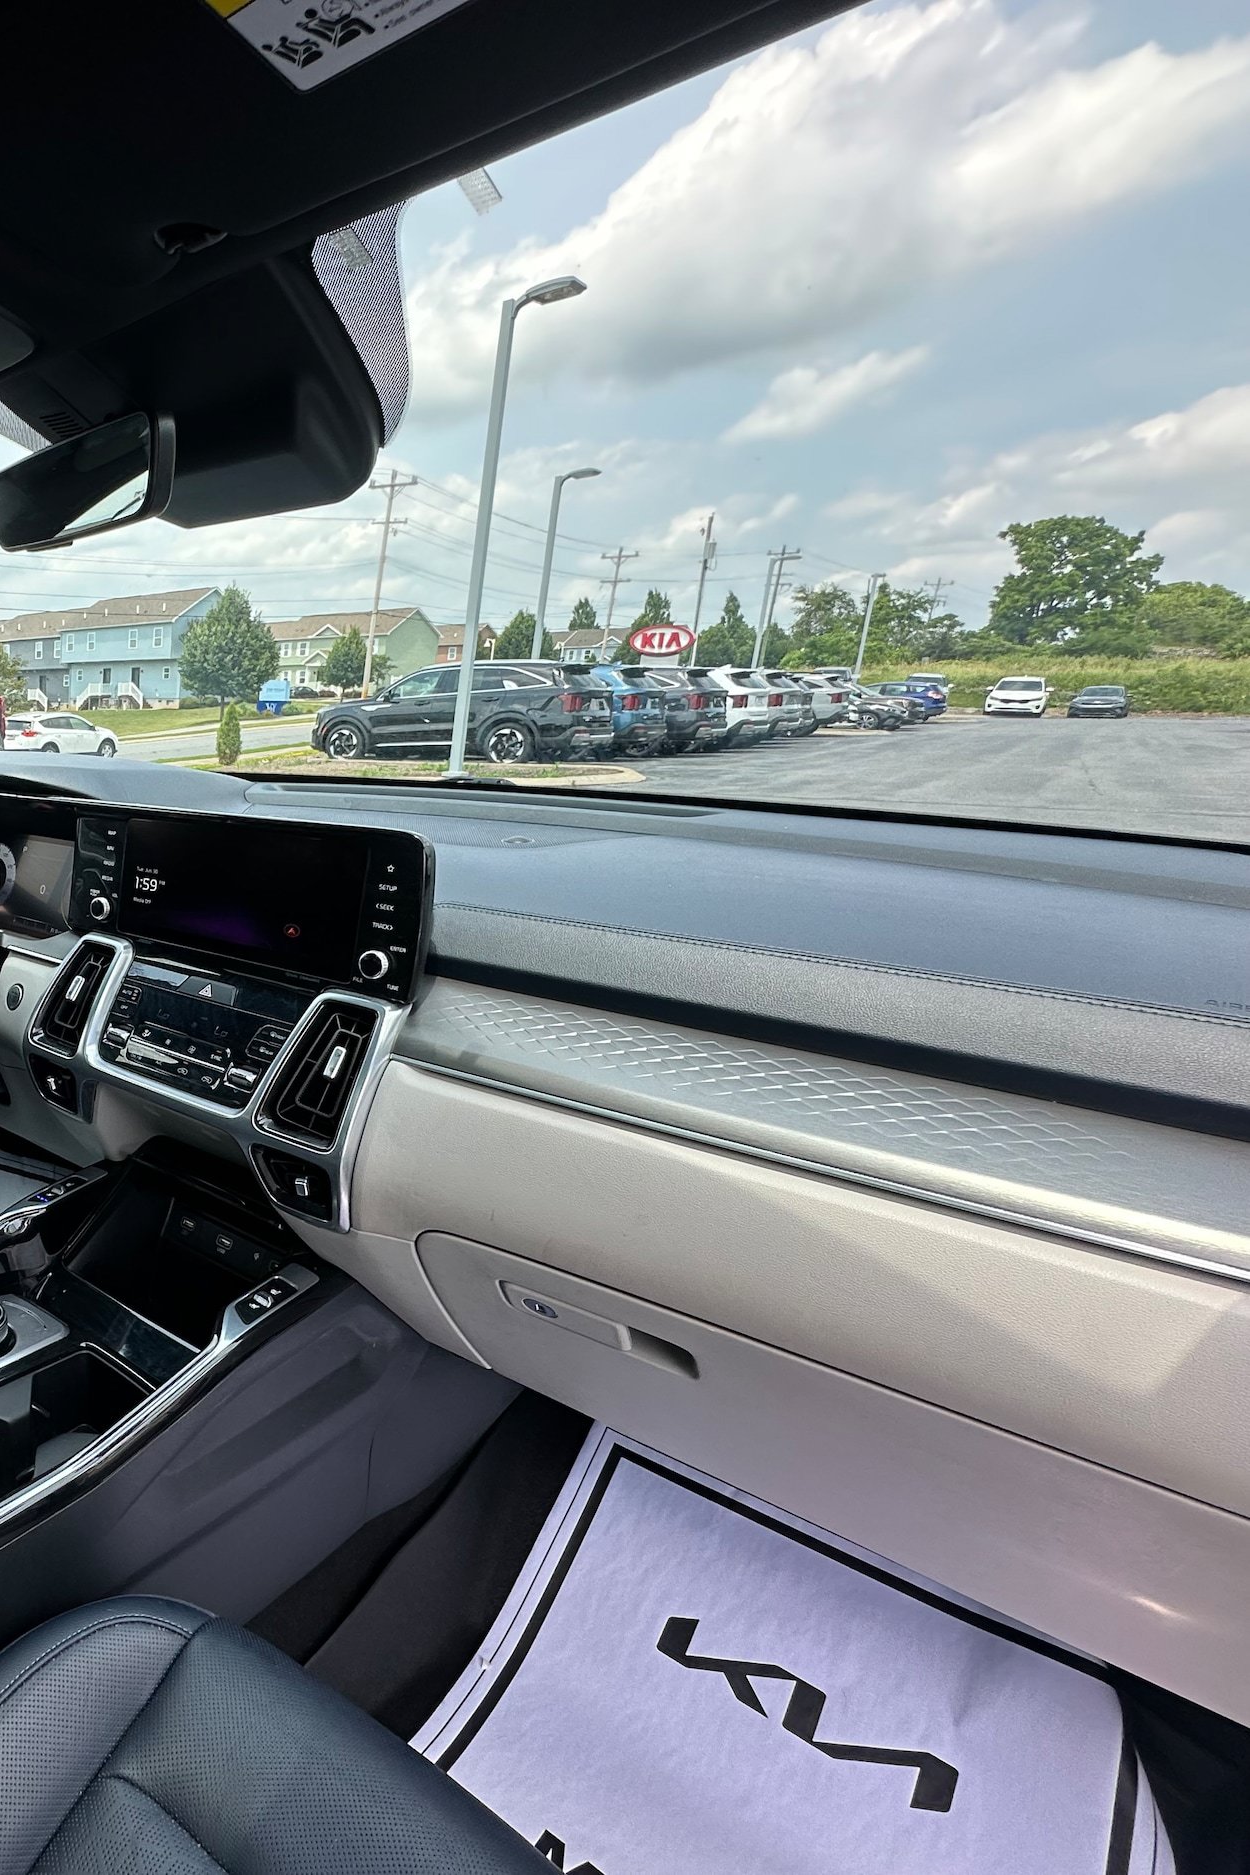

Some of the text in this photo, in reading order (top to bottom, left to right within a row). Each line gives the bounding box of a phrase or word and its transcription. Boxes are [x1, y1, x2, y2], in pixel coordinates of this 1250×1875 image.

[640, 632, 682, 649] KIA
[135, 875, 158, 892] 1:59
[378, 884, 397, 892] SETUP
[40, 884, 46, 895] 0
[387, 984, 399, 992] TUNE
